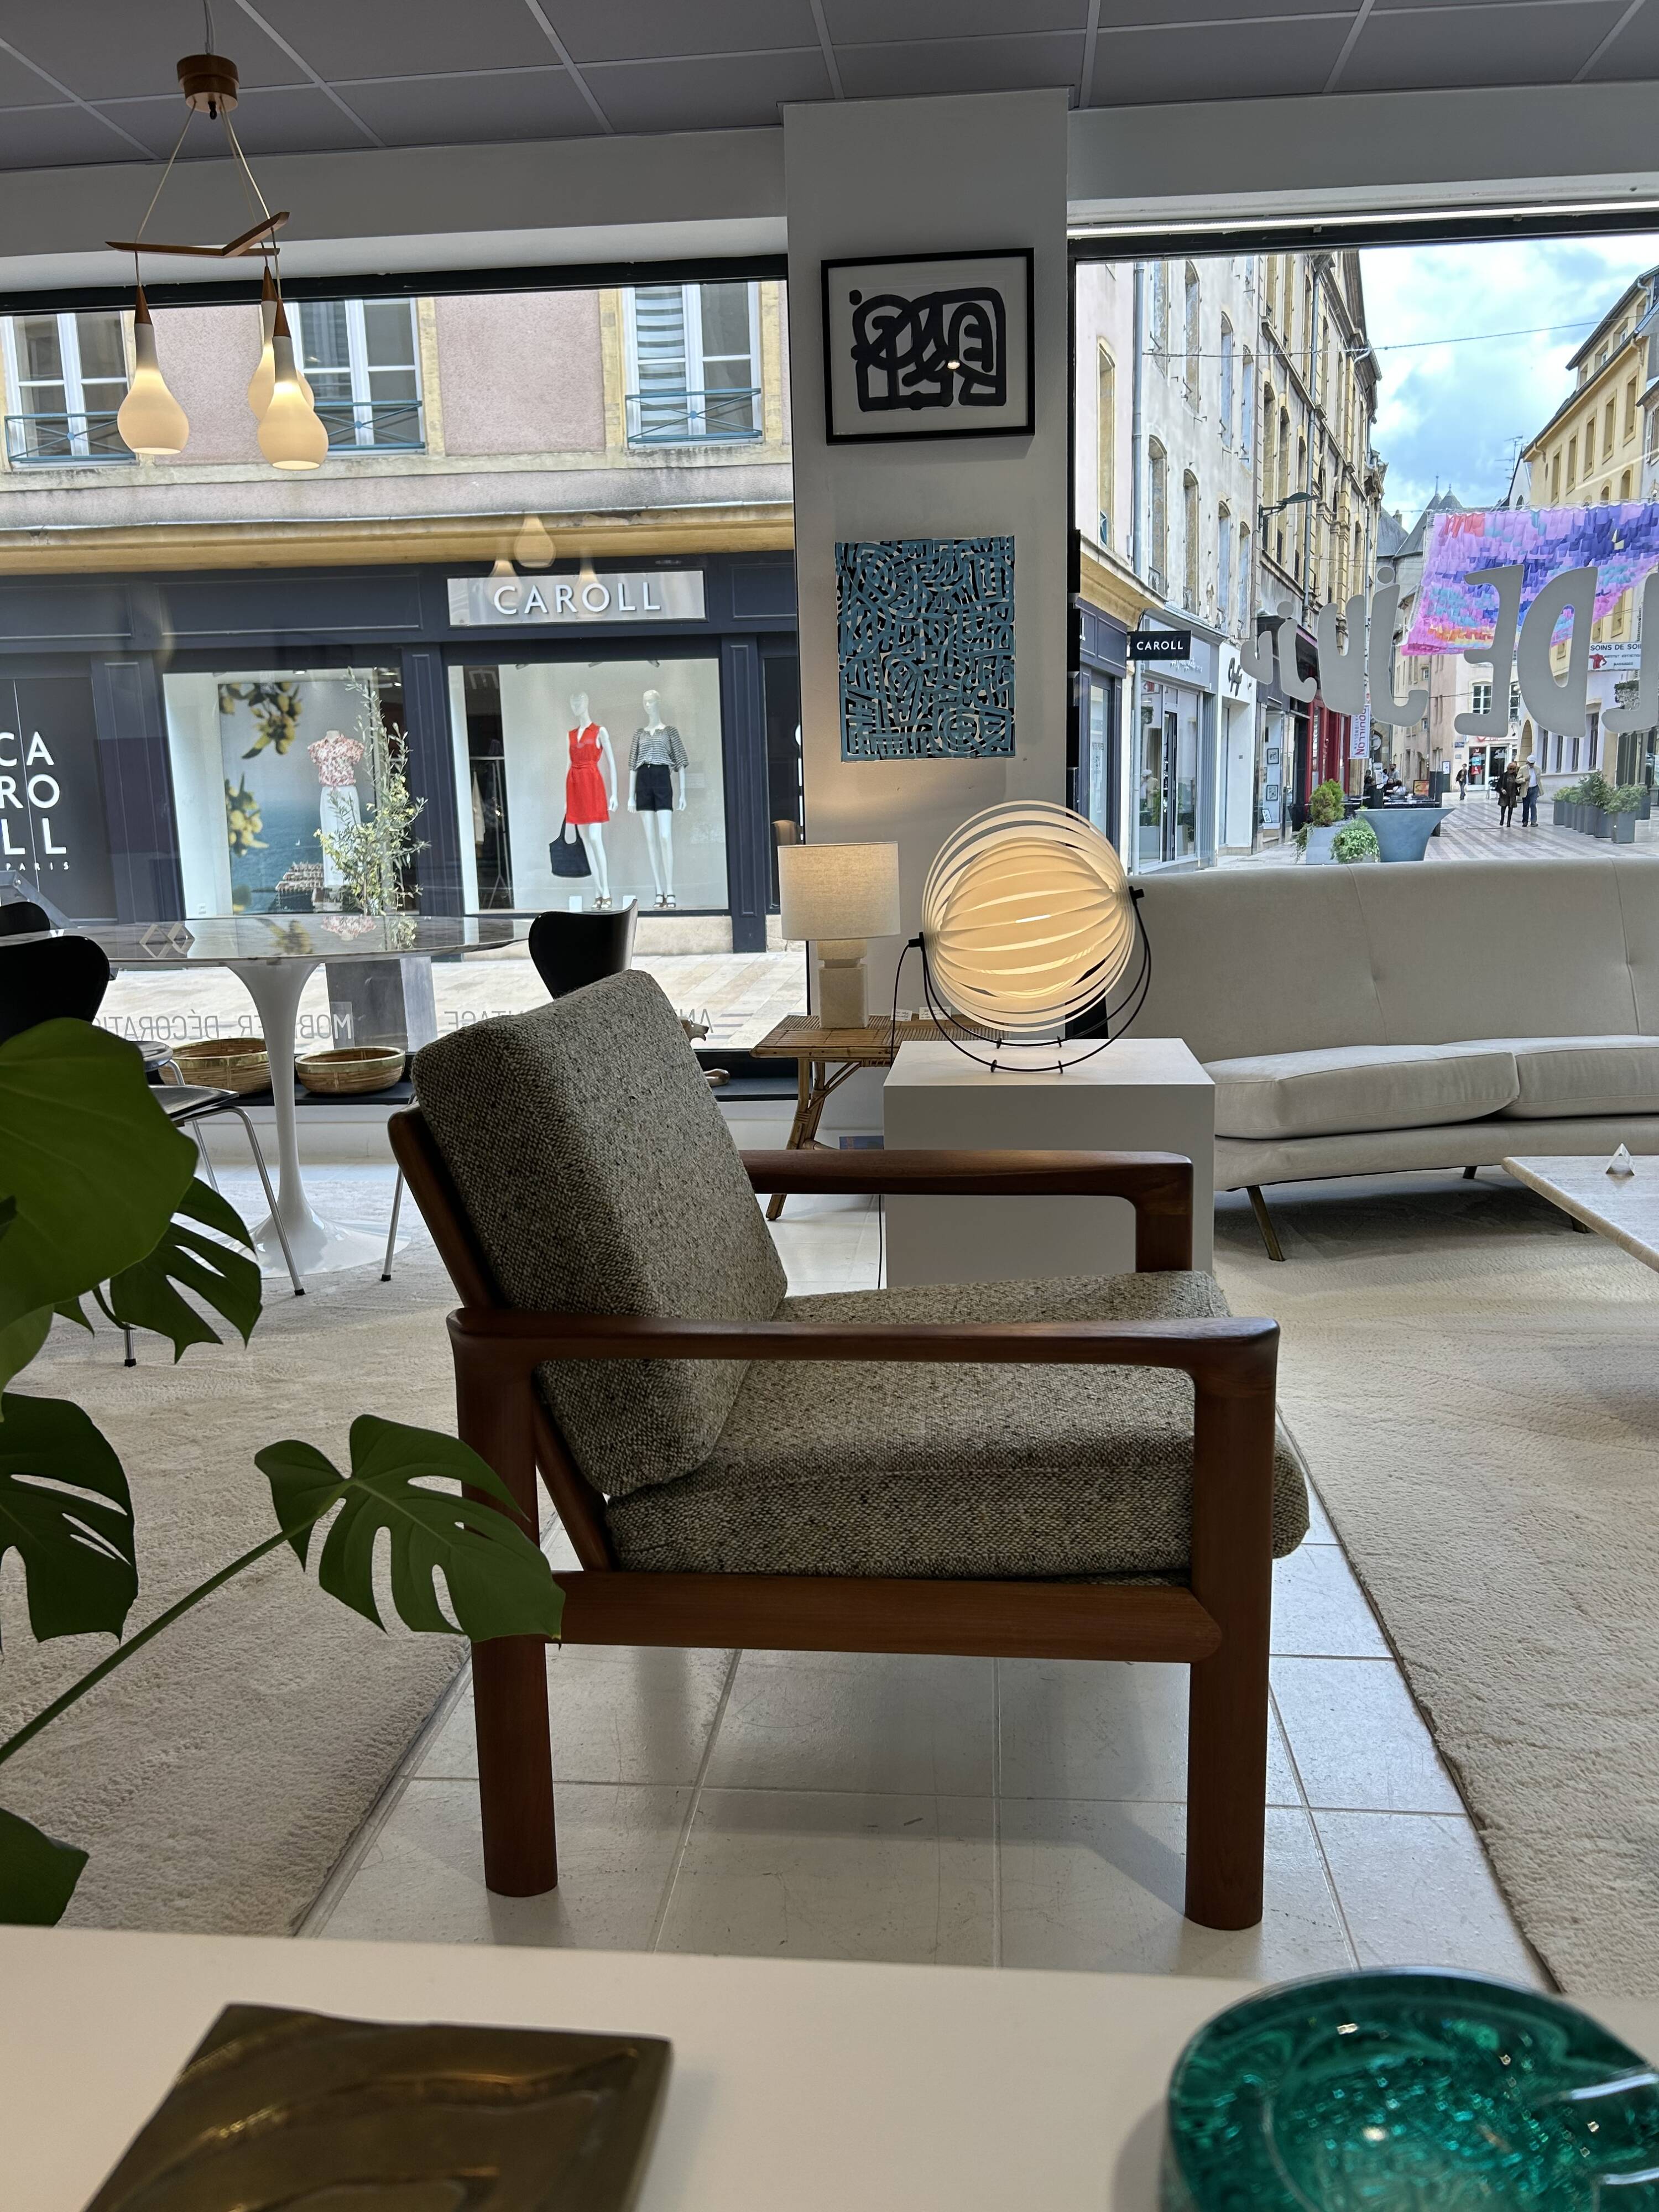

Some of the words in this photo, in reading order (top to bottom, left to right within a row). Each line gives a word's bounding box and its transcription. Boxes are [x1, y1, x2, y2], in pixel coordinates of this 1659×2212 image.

[493, 582, 661, 615] CAROLL
[1136, 640, 1183, 651] CAROLL
[0, 731, 54, 768] CA
[0, 774, 60, 809] RO
[1, 818, 67, 855] LL
[6, 861, 70, 871] PARIS
